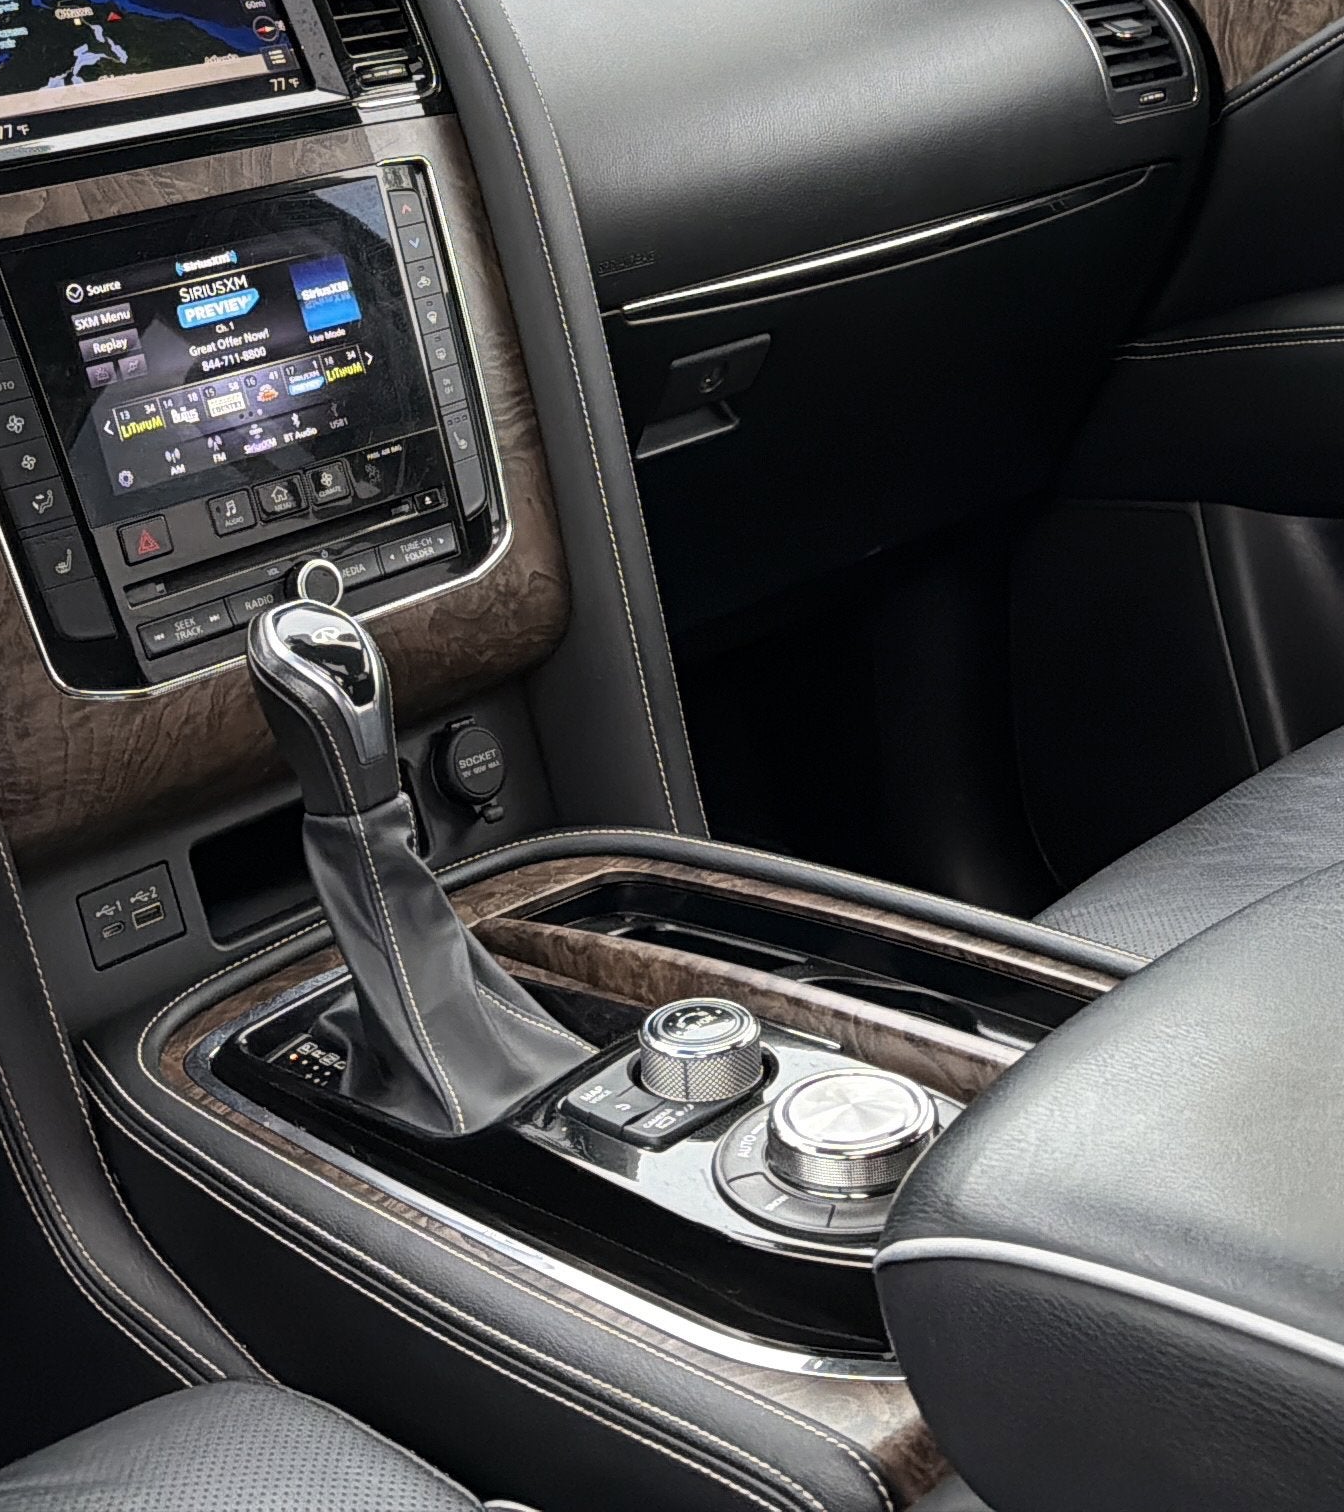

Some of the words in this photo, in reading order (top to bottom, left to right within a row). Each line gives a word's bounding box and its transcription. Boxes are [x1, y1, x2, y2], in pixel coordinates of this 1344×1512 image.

[269, 77, 286, 92] 77
[86, 280, 122, 297] Source
[178, 274, 249, 303] SIRIUSXM
[74, 317, 99, 332] SXM
[100, 309, 131, 325] Menu
[215, 324, 229, 335] Ch.
[308, 332, 325, 345] Live
[325, 327, 346, 340] Mode
[92, 337, 129, 355] Replay
[188, 341, 218, 357] Great
[217, 335, 243, 350] Offer
[243, 328, 270, 344] Now!
[201, 346, 267, 372] 844-711-8800
[345, 349, 357, 361] 34
[245, 375, 256, 386] 16
[268, 370, 279, 381] 41
[285, 365, 295, 376] 17
[204, 387, 215, 398] 15
[119, 409, 131, 420] 13
[143, 403, 156, 415] 34
[162, 398, 174, 409] 14
[283, 432, 295, 444] BT
[294, 427, 318, 440] Audio
[212, 451, 227, 464] FM
[170, 463, 187, 476] AM
[404, 546, 435, 562] FOLDER
[244, 593, 274, 611] RADIO
[174, 615, 197, 631] SEEK
[174, 624, 204, 642] TRACK
[458, 748, 497, 769] SOCKET
[149, 886, 158, 899] 2
[578, 1085, 604, 1103] MAP
[737, 1135, 756, 1159] AUTO
